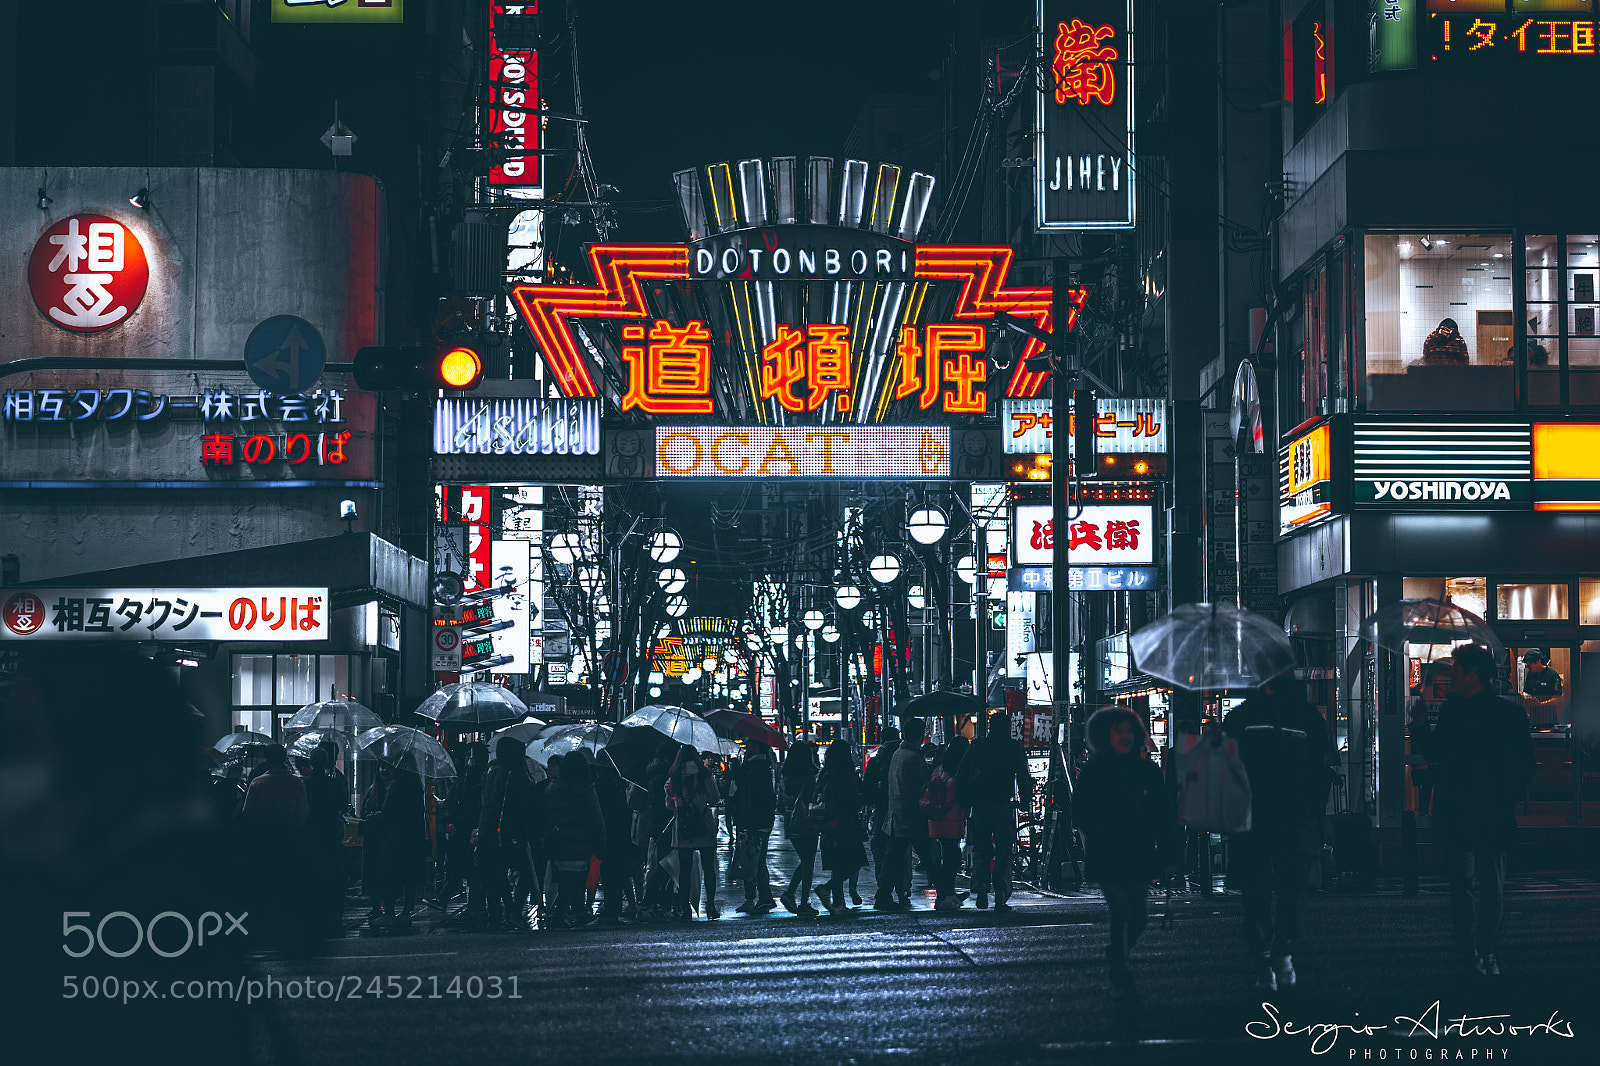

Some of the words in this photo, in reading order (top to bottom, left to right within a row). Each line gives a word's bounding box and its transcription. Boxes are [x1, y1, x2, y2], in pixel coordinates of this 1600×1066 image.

[1050, 153, 1121, 191] JIHEY
[697, 247, 908, 275] DOTONBORI
[621, 320, 989, 414] 道頓堀
[2, 388, 347, 422] 相互タクシー株式会社
[453, 401, 580, 451] Asahi
[201, 432, 352, 466] 南のりば
[657, 431, 851, 475] OCAT
[1373, 481, 1511, 500] YOSHINOYA
[52, 597, 223, 632] 相互タクシー
[228, 596, 322, 631] のりば
[440, 633, 454, 646] 30
